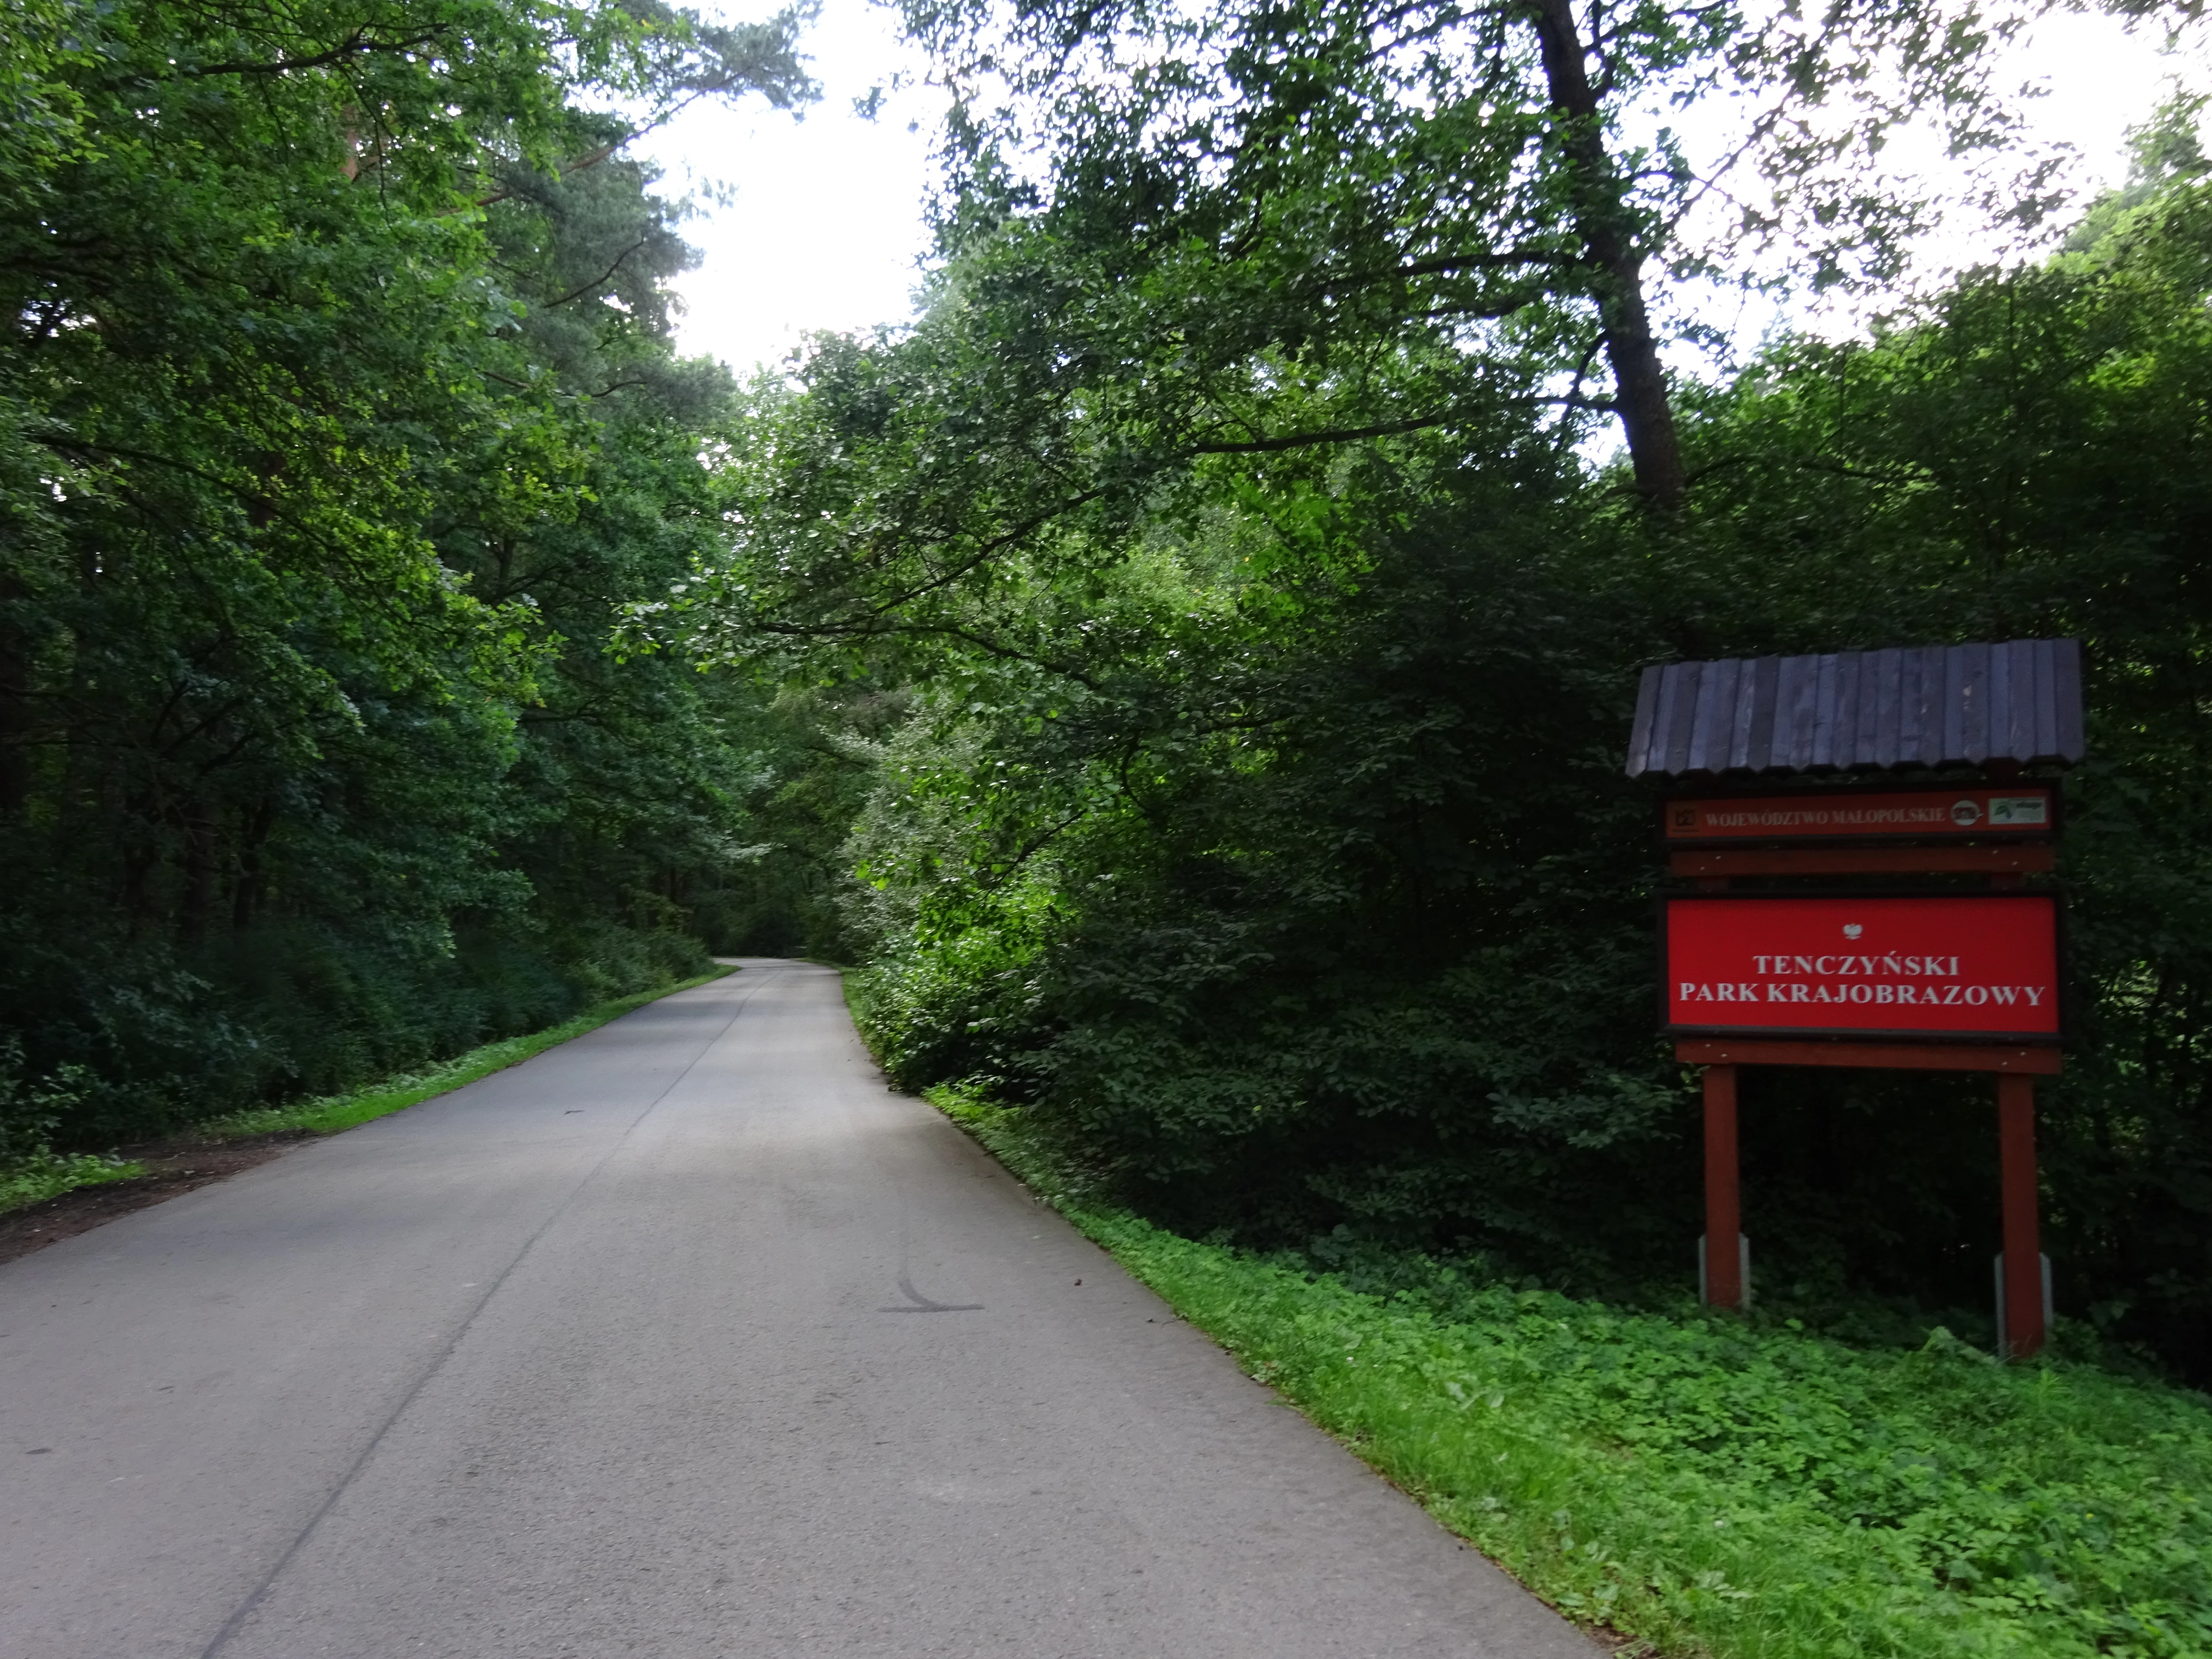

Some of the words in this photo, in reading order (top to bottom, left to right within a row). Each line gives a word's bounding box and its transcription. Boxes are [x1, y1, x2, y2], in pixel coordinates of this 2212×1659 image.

[1705, 808, 1828, 827] WOJEWÓDZTWO
[1752, 950, 1959, 975] TENCZYŃSKI
[1679, 982, 1760, 1002] PARK
[1767, 983, 2046, 1006] KRAJOBRAZOWY
